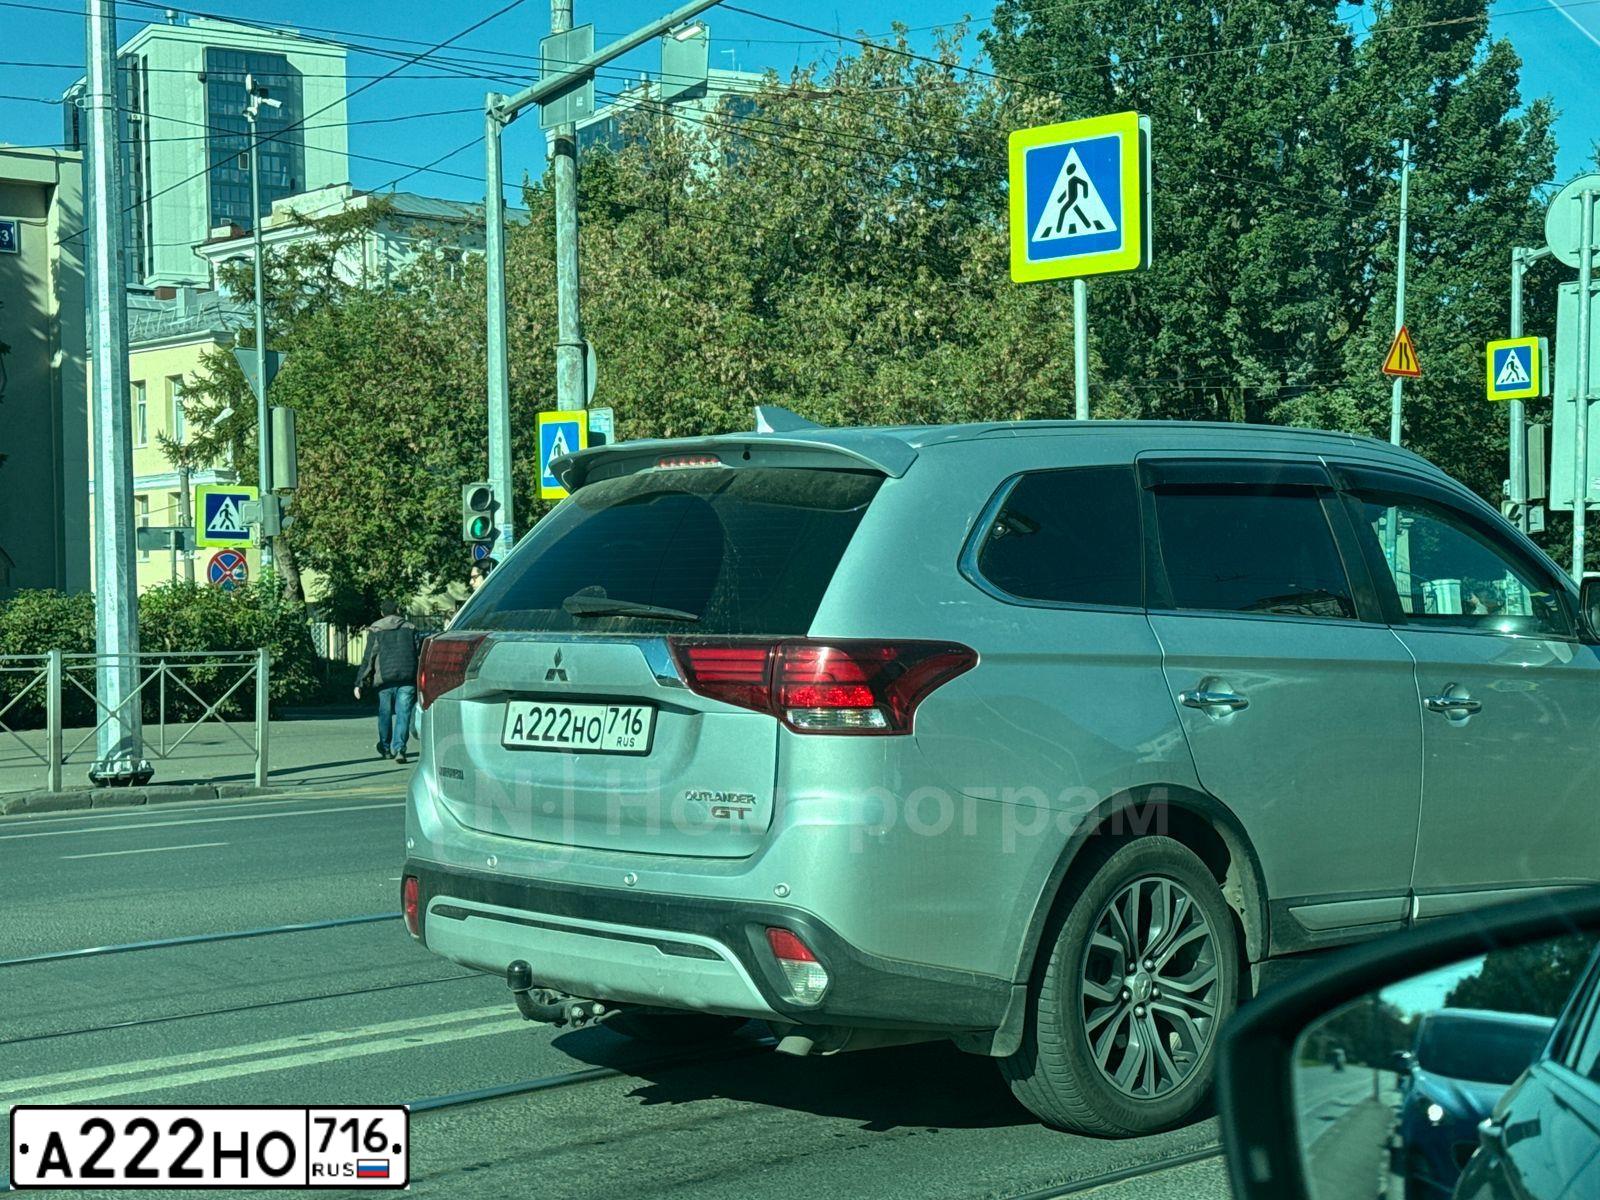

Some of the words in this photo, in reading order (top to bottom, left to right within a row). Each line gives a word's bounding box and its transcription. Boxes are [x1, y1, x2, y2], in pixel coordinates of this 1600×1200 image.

[608, 707, 643, 735] 716
[616, 736, 636, 748] RUS
[685, 790, 756, 805] OUTLANDER
[711, 805, 752, 820] GT
